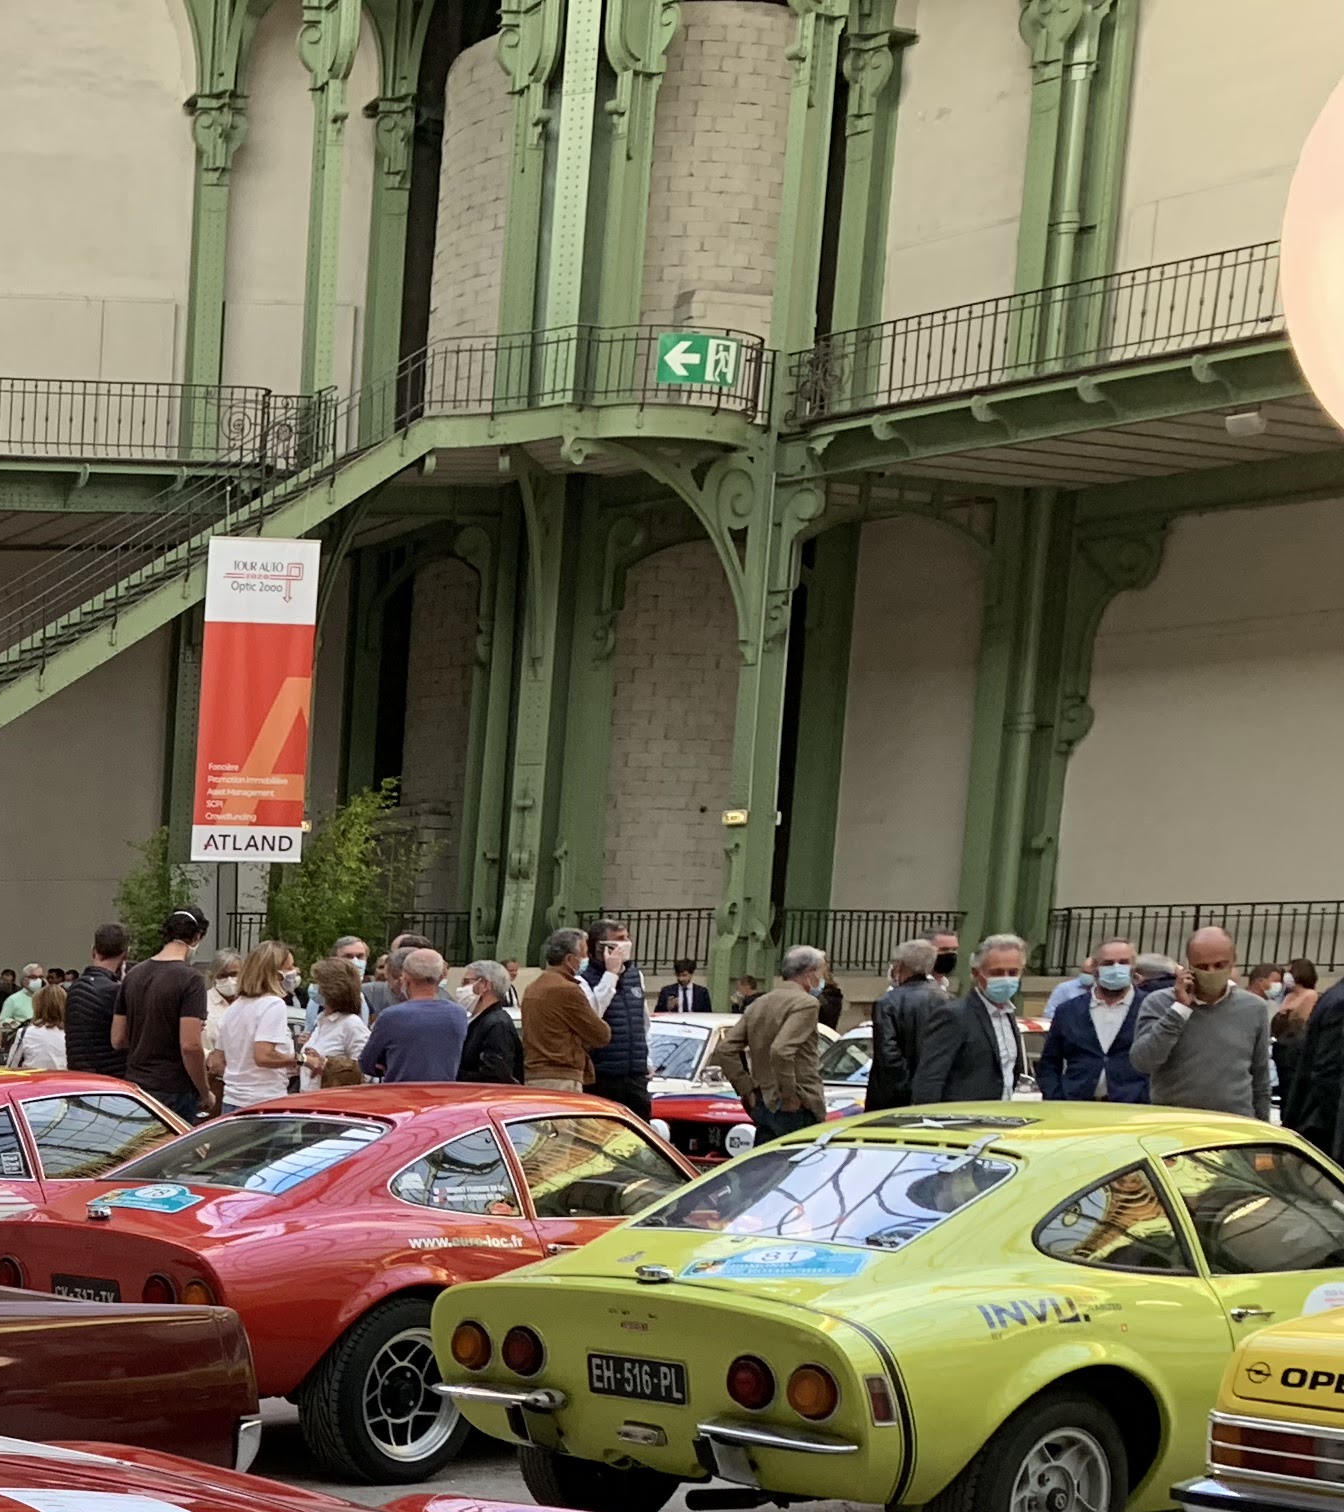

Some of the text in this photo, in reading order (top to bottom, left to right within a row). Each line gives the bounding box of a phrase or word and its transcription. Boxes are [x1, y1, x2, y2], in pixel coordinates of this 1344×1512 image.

[233, 560, 284, 572] TOUR AUTO
[230, 581, 283, 594] Optic 2000
[203, 834, 293, 851] ATLAND
[591, 1357, 683, 1400] EH-516-PL
